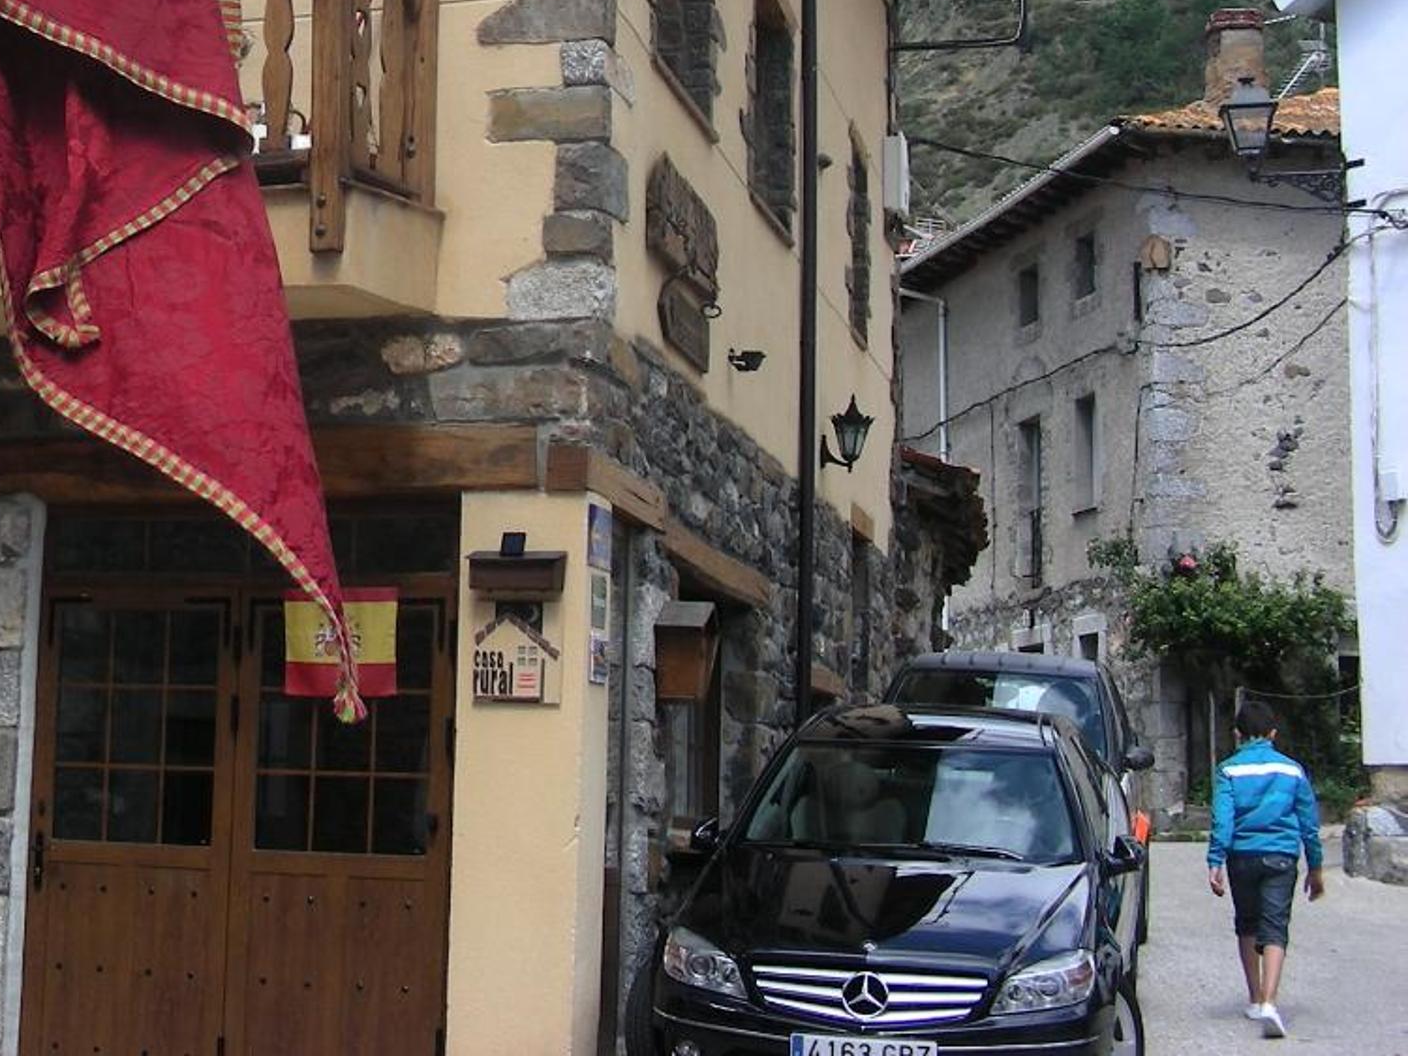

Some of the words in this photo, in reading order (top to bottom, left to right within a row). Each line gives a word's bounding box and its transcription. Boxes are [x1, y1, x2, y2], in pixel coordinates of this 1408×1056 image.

[474, 650, 503, 668] casa
[473, 661, 513, 695] rural
[808, 1039, 871, 1056] 4163
